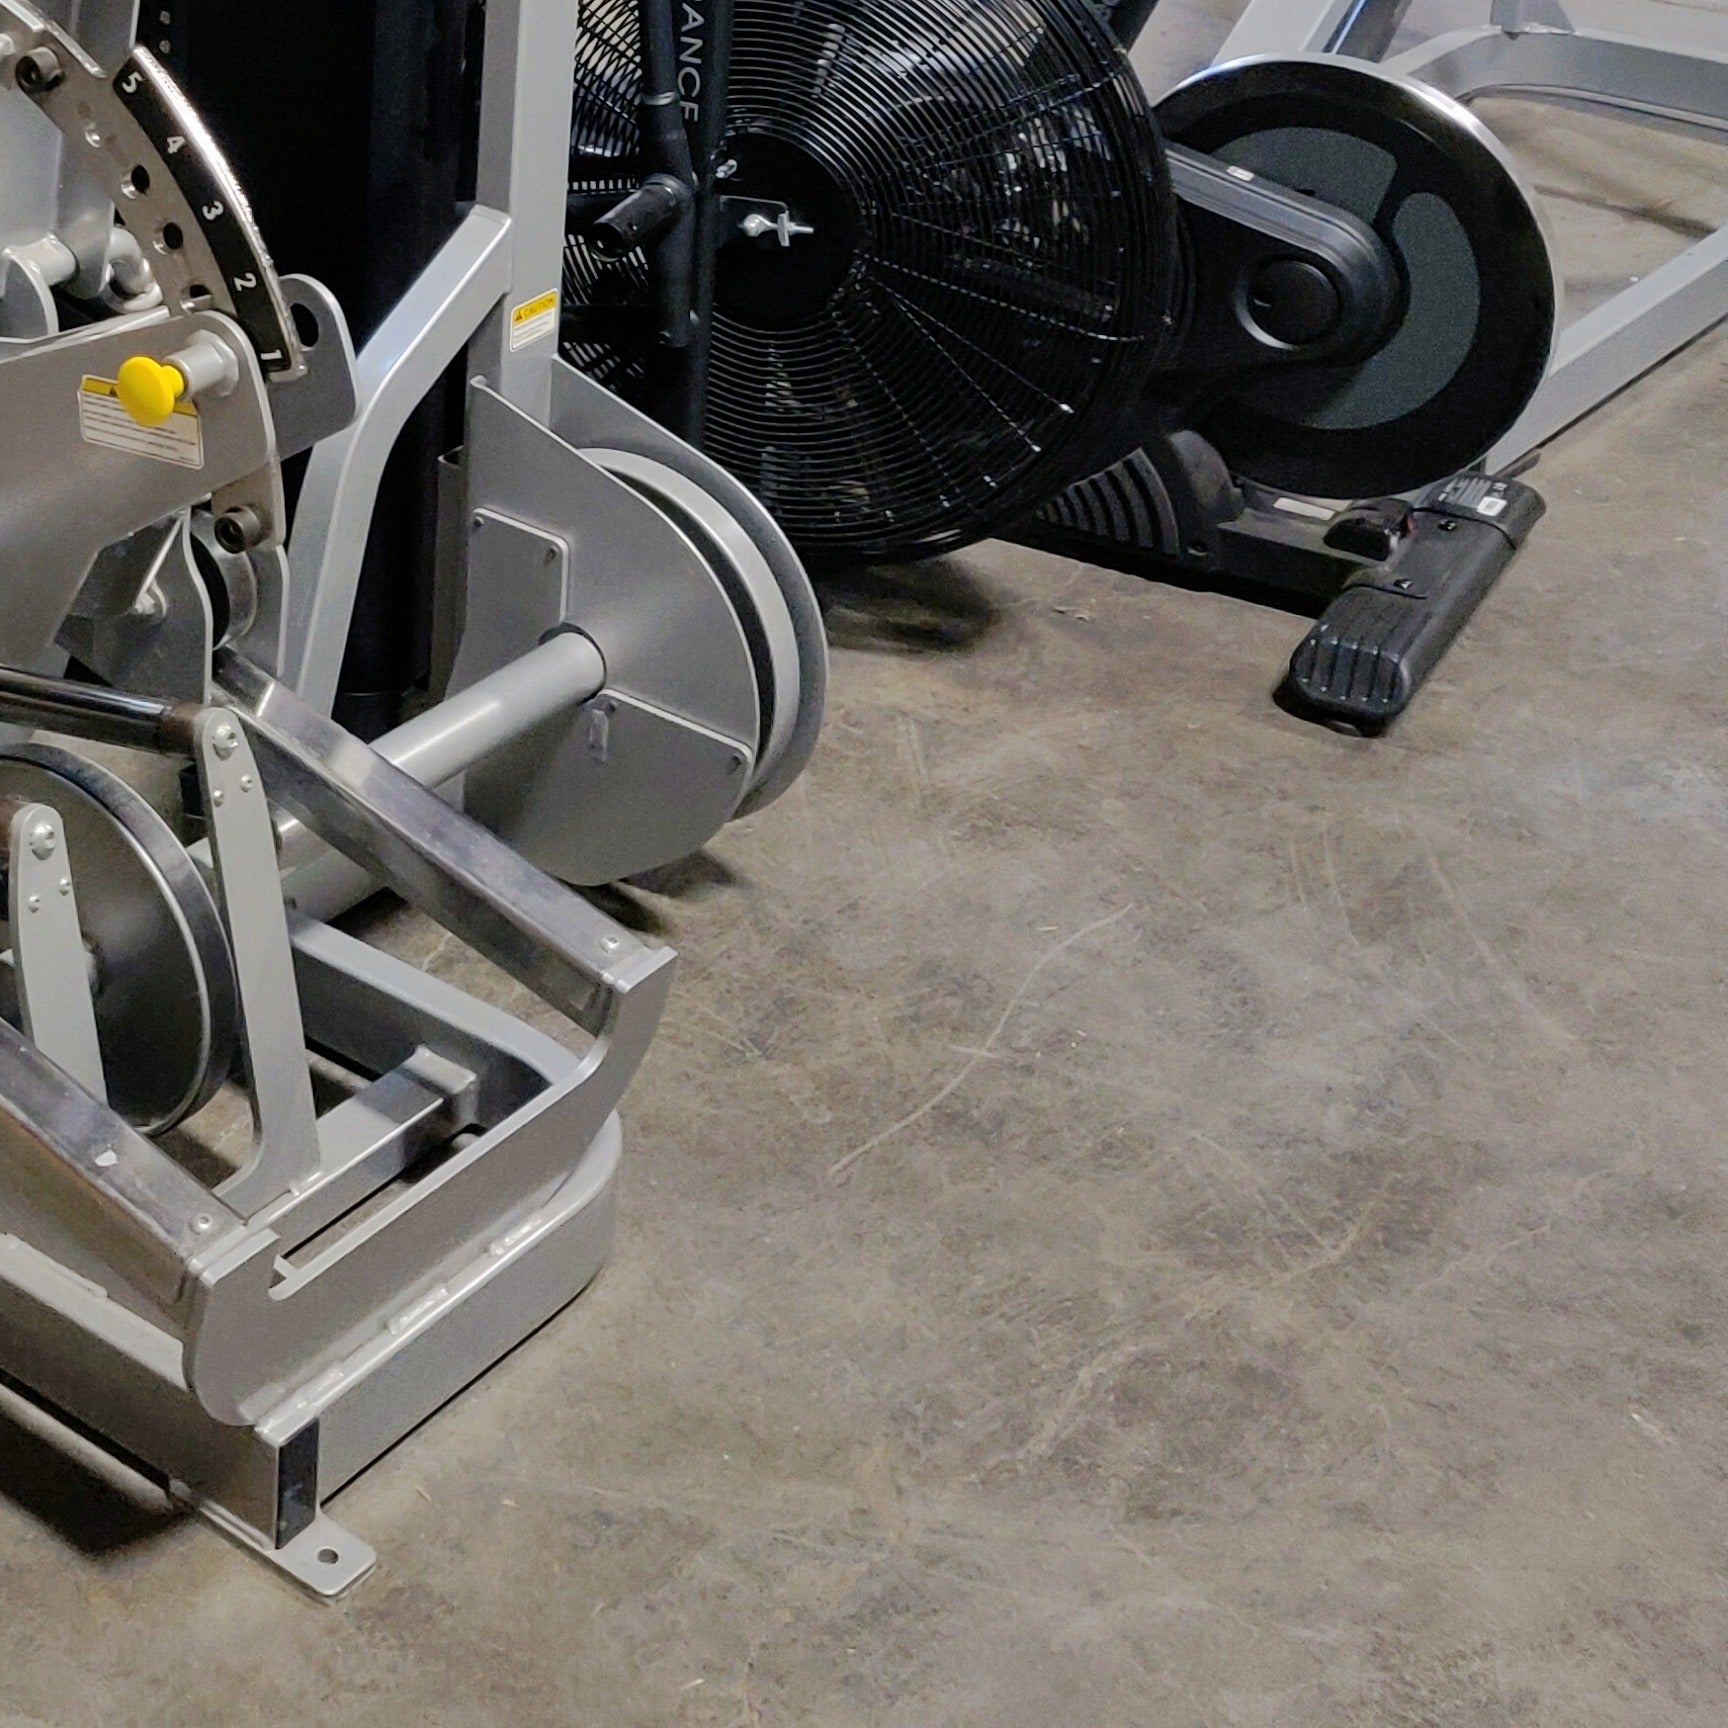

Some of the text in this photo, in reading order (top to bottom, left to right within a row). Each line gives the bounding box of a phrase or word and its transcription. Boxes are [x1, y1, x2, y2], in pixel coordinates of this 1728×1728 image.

[121, 71, 144, 94] 5
[165, 134, 187, 155] 4
[201, 200, 225, 222] 3
[232, 272, 258, 293] 2
[259, 348, 283, 362] 1
